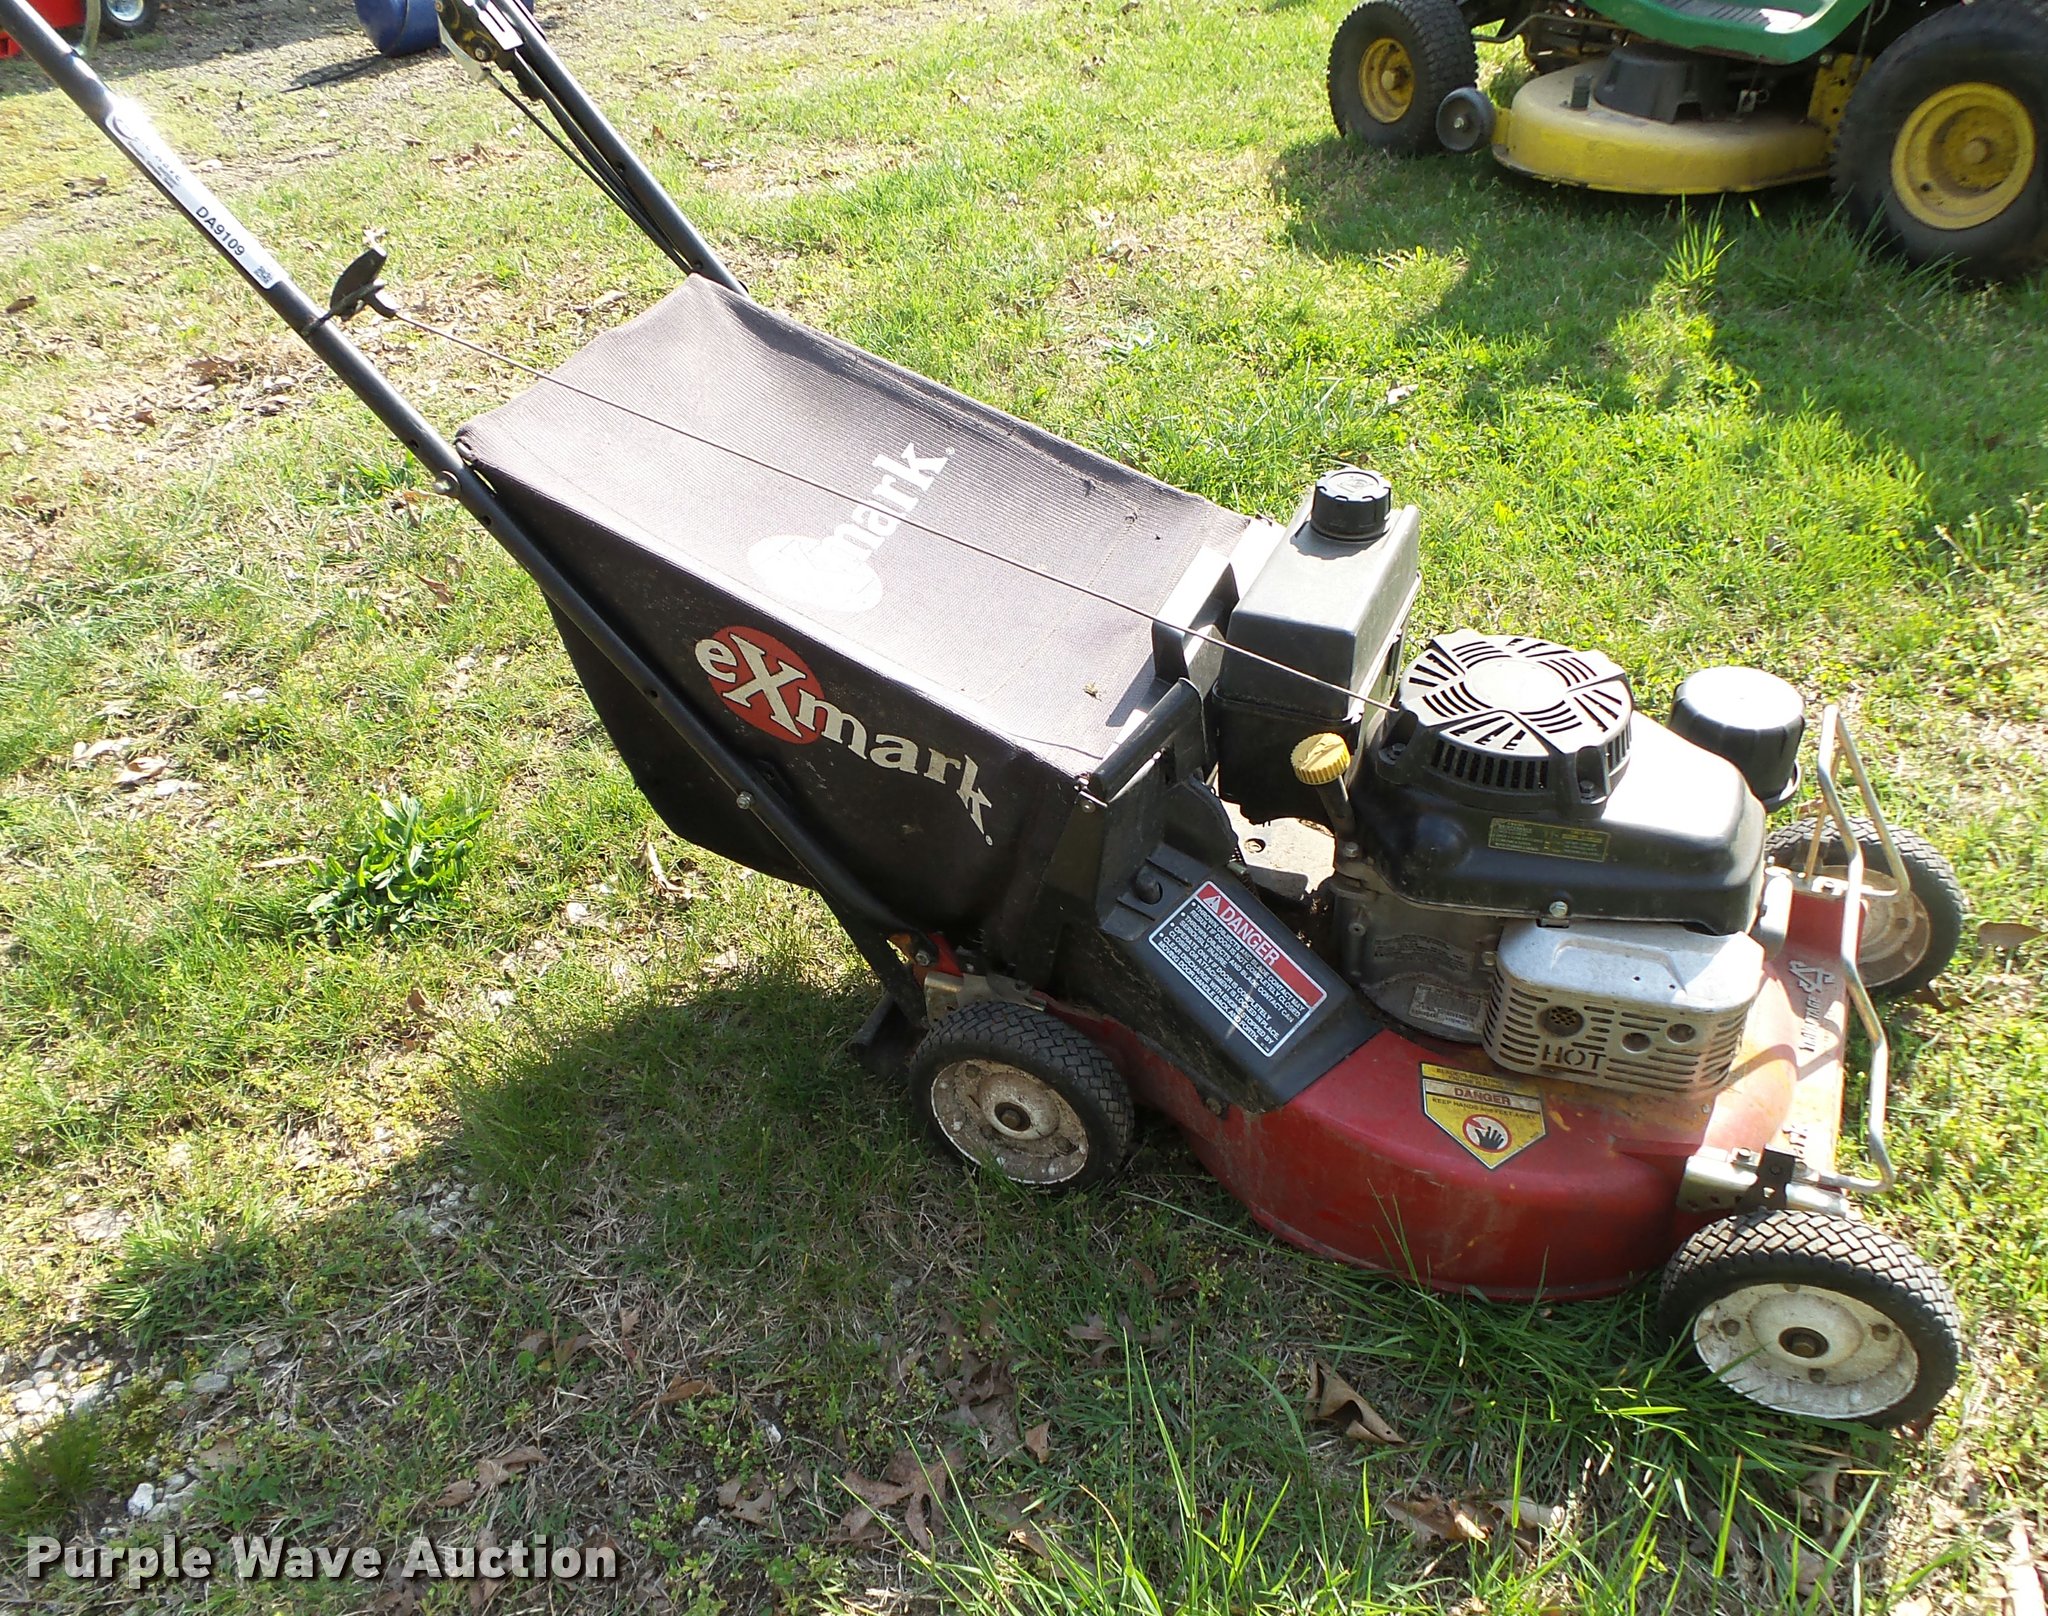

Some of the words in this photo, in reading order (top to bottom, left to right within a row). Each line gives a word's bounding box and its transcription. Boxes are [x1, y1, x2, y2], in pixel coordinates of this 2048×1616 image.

[196, 206, 245, 256] DA9109
[1173, 925, 1199, 951] OPERATE
[1196, 948, 1213, 964] ONLY
[1210, 961, 1218, 969] IF
[1215, 966, 1233, 984] DOOR
[1230, 981, 1238, 989] IS
[1235, 986, 1272, 1021] COMPLETELY
[1179, 919, 1209, 949] SERIOUSLY
[1183, 915, 1208, 939] THROWN
[1205, 936, 1231, 961] OBJECTS
[1228, 958, 1242, 971] AND
[1239, 968, 1259, 988] BLADE
[1256, 985, 1283, 1011] CONTACT
[1280, 1008, 1295, 1022] CAN
[1189, 909, 1211, 931] RESULT
[1208, 928, 1216, 936] IF
[1214, 933, 1231, 950] DOOR
[1228, 947, 1237, 955] IS
[1234, 952, 1248, 966] NOT
[1244, 962, 1281, 997] COMPLETELY
[1194, 905, 1219, 928] THROWN
[1216, 925, 1241, 950] OBJECTS
[1239, 948, 1252, 961] AND
[1250, 958, 1270, 977] BLADE
[1267, 974, 1294, 1000] CONTACT
[1291, 997, 1305, 1011] MAY
[1218, 905, 1281, 966] DANGER
[1157, 940, 1180, 962] MOVING
[1177, 959, 1195, 977] DOOR
[1192, 974, 1215, 997] HANDLE
[1213, 994, 1230, 1012] BACK
[1227, 1009, 1241, 1023] AND
[1162, 935, 1182, 955] CLEAR
[1179, 952, 1211, 983] DISCHARGE
[1208, 980, 1224, 996] WITH
[1221, 993, 1243, 1015] ENGINE
[1240, 1011, 1266, 1037] STOPPED
[1263, 1034, 1274, 1045] BY
[1168, 930, 1191, 952] CLOSED
[1188, 949, 1199, 960] OR
[1196, 957, 1231, 992] ATTACHMENT
[1228, 989, 1237, 997] IS
[1234, 994, 1257, 1017] LOCKED
[1254, 1014, 1262, 1022] IN
[1454, 1087, 1511, 1106] DANGER
[1542, 1044, 1607, 1070] HOT
[1454, 1101, 1479, 1110] HANDS
